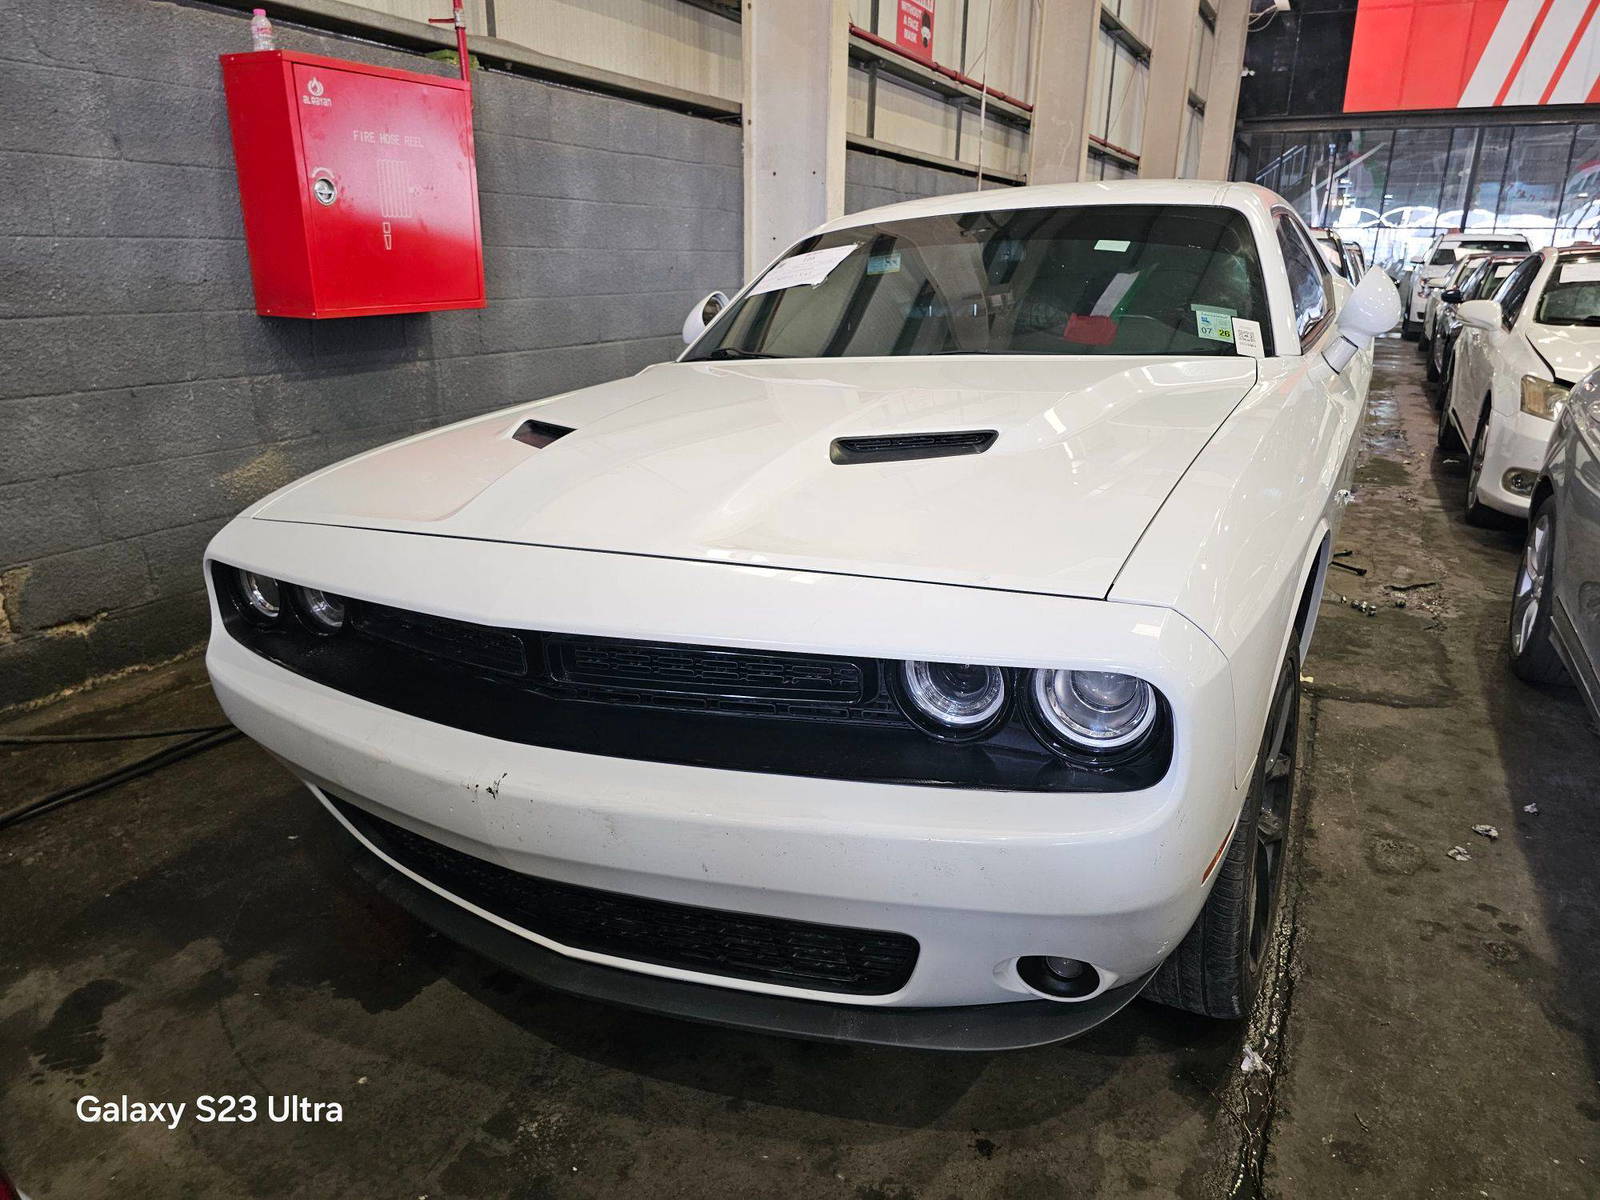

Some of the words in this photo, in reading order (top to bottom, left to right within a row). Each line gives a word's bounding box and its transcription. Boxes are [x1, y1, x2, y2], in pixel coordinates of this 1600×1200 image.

[352, 129, 376, 144] FIRE
[379, 132, 401, 146] HOSE
[404, 135, 424, 148] REEL
[1219, 329, 1231, 338] 26
